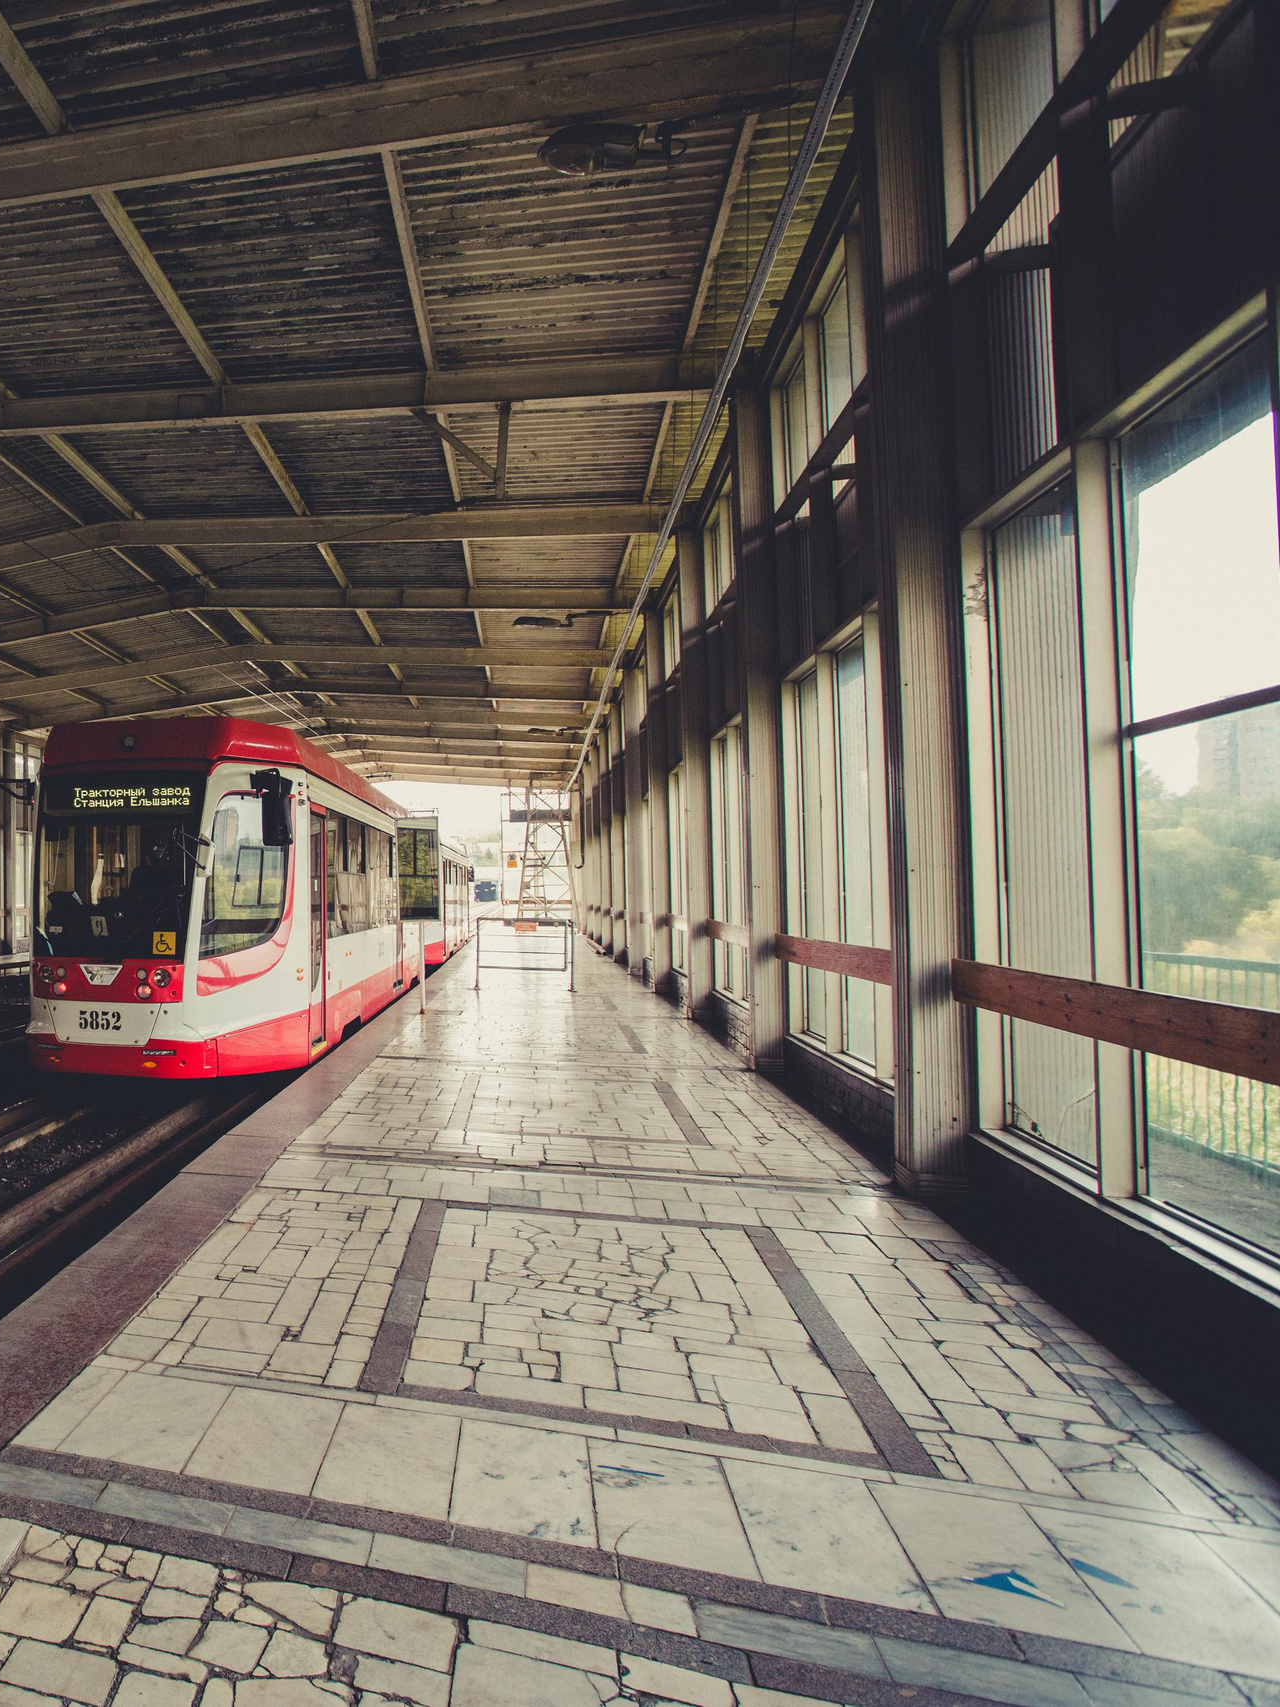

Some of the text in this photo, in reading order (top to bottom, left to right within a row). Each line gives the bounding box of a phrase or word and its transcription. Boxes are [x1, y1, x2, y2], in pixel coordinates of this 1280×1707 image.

[74, 787, 191, 798] Тракторный завод
[74, 797, 190, 808] Станция Ельшанка
[79, 1010, 122, 1031] 5852
